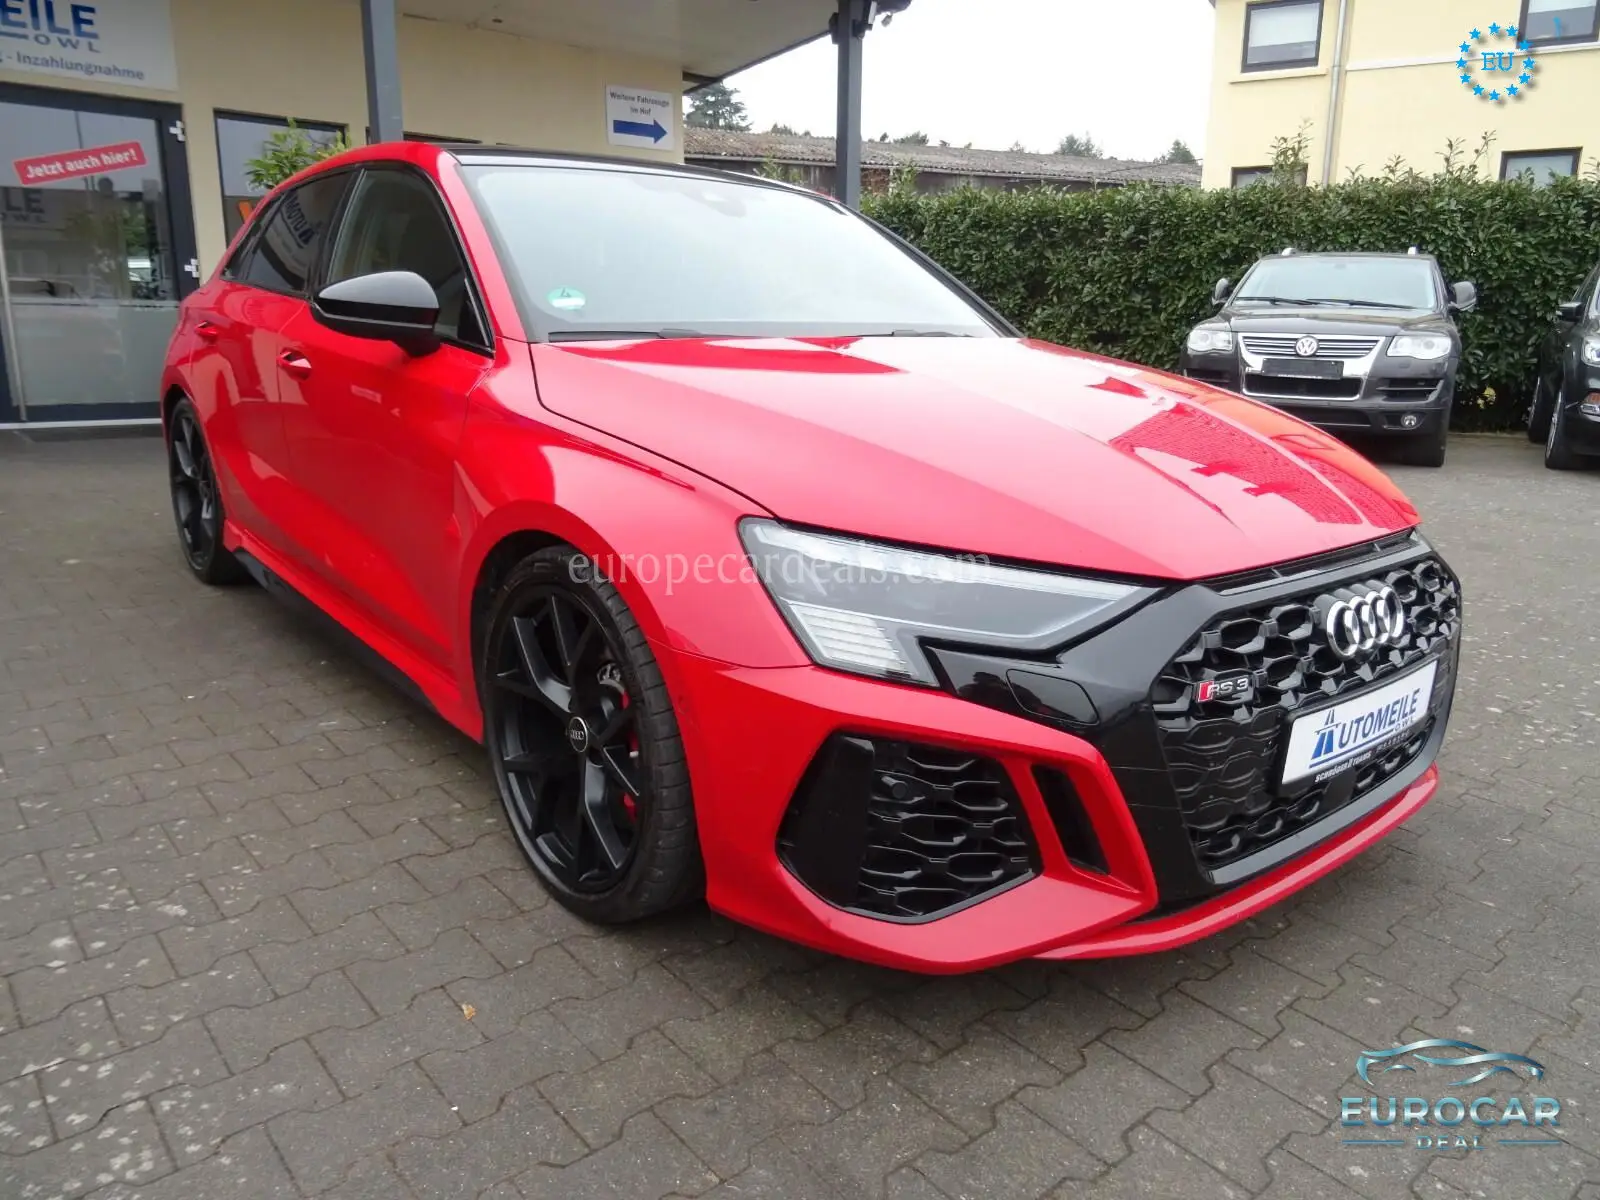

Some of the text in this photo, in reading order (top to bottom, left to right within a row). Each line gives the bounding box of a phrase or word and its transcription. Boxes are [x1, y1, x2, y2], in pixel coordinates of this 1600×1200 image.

[34, 34, 101, 53] OWL
[16, 51, 145, 80] Inzahlungnahme
[26, 148, 138, 178] Jetzt auch hier!
